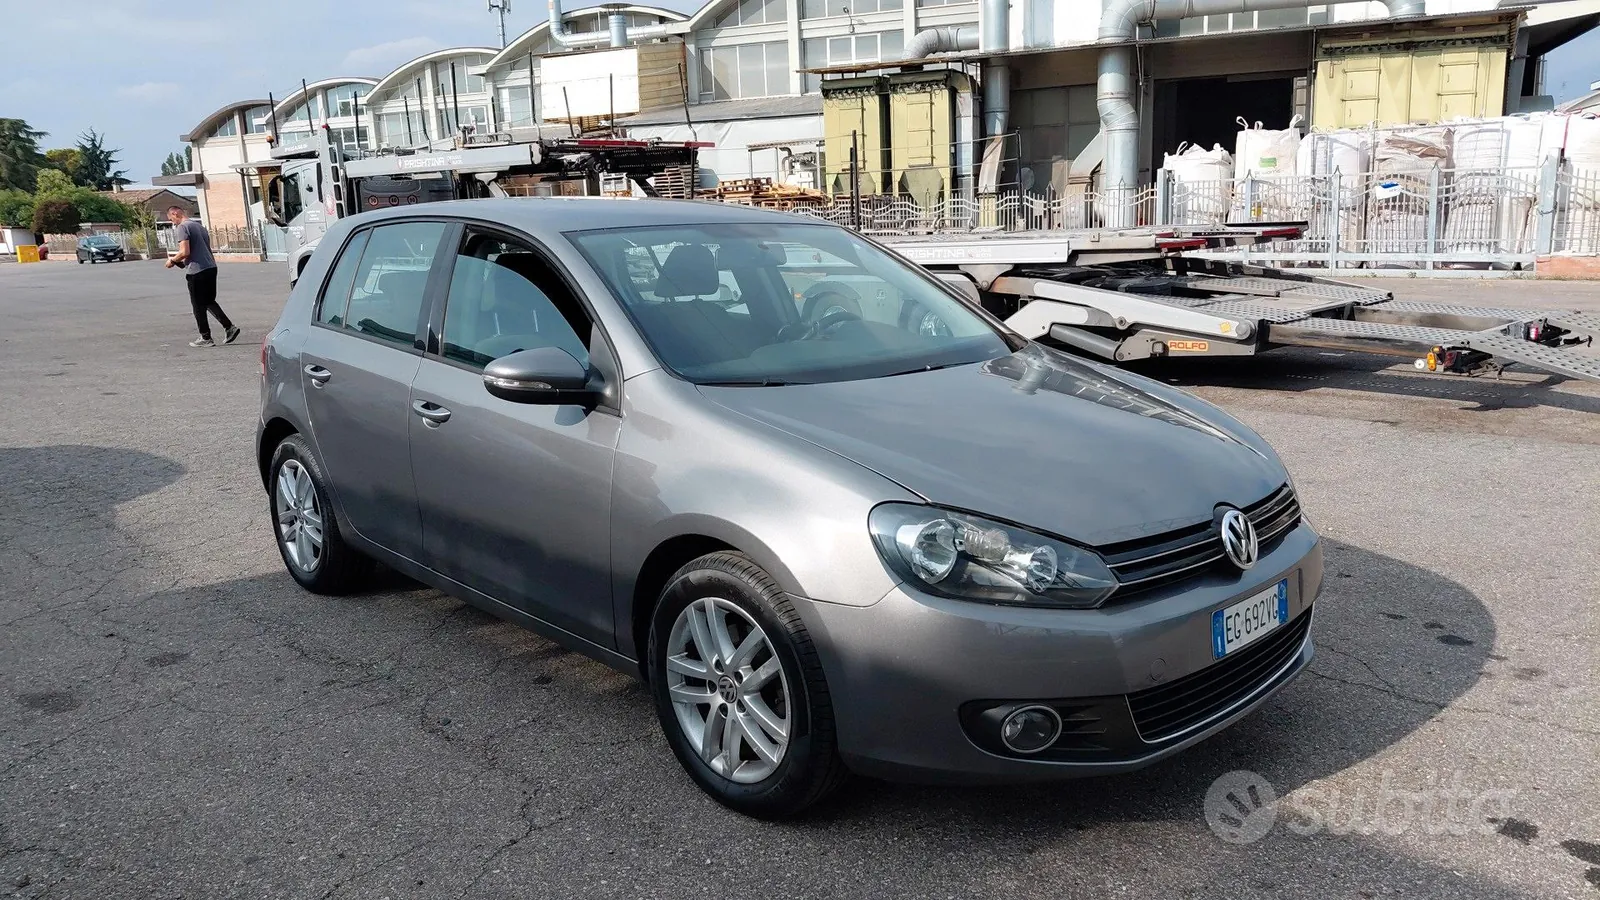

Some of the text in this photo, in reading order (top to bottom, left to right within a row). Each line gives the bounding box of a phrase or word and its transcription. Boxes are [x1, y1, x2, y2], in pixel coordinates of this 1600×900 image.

[404, 157, 445, 169] PRISHTINA
[1169, 341, 1207, 350] ROLFO
[1225, 611, 1241, 645] EG
[1244, 592, 1278, 635] 692VG
